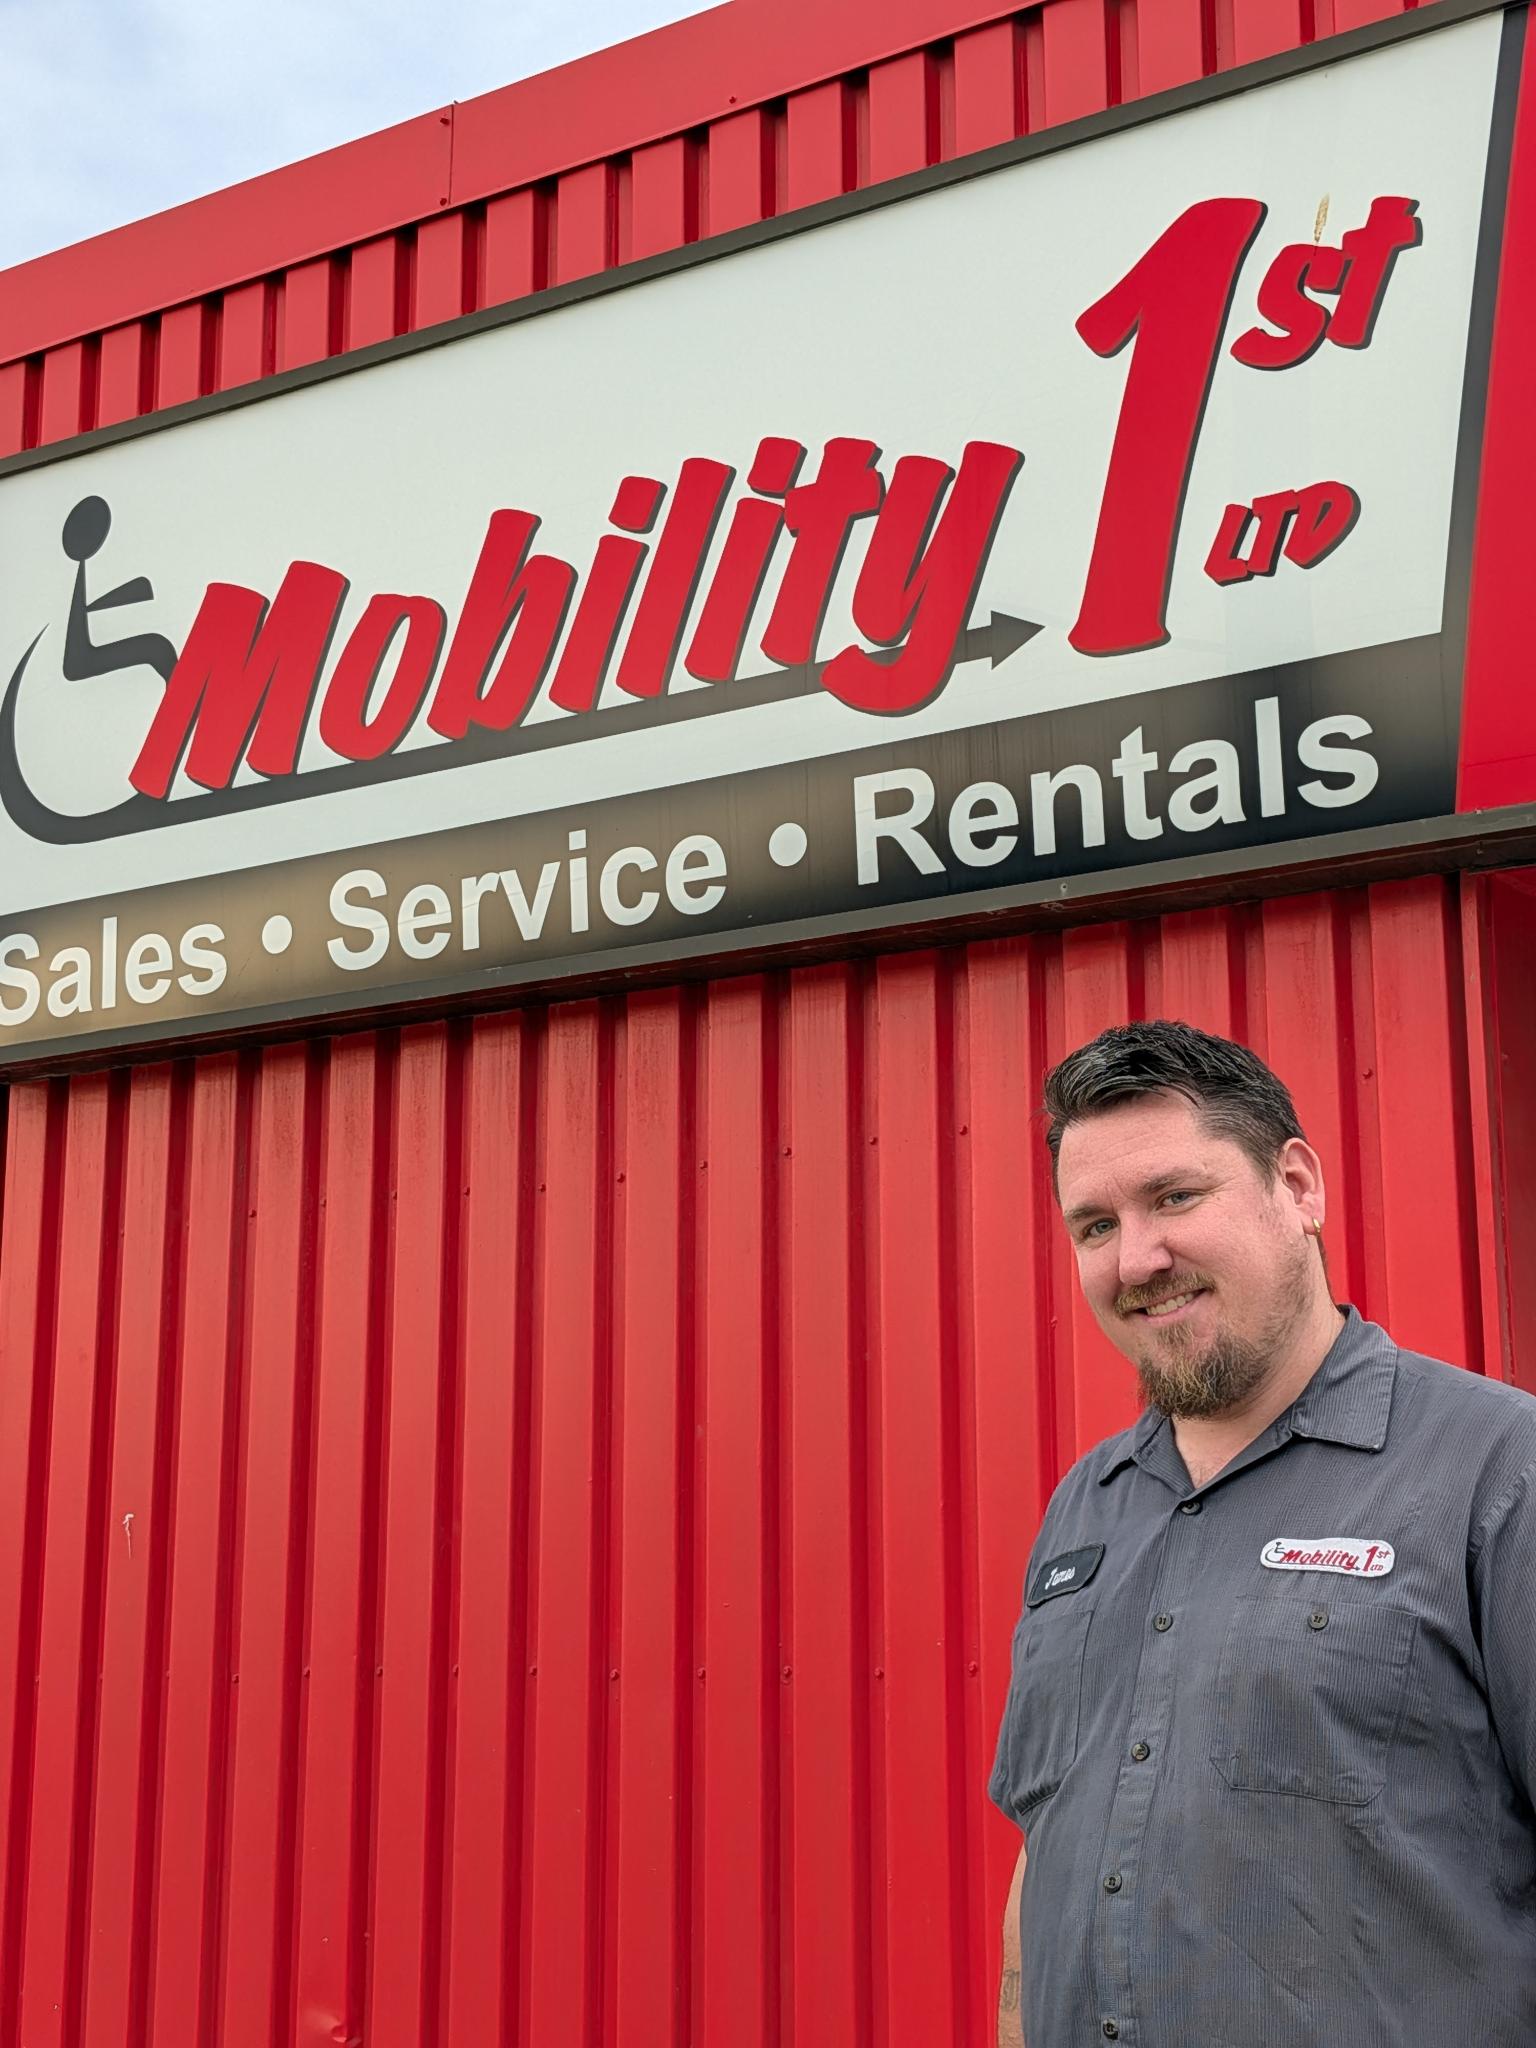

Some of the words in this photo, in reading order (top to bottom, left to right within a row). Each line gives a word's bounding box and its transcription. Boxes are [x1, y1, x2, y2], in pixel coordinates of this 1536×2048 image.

[128, 436, 1026, 801] Mobility
[1068, 196, 1423, 657] 1st
[1203, 480, 1361, 586] LTD
[0, 916, 228, 1026] Sales
[327, 829, 727, 971] Service
[853, 696, 1379, 886] Rentals
[1280, 1549, 1359, 1571] Mobility
